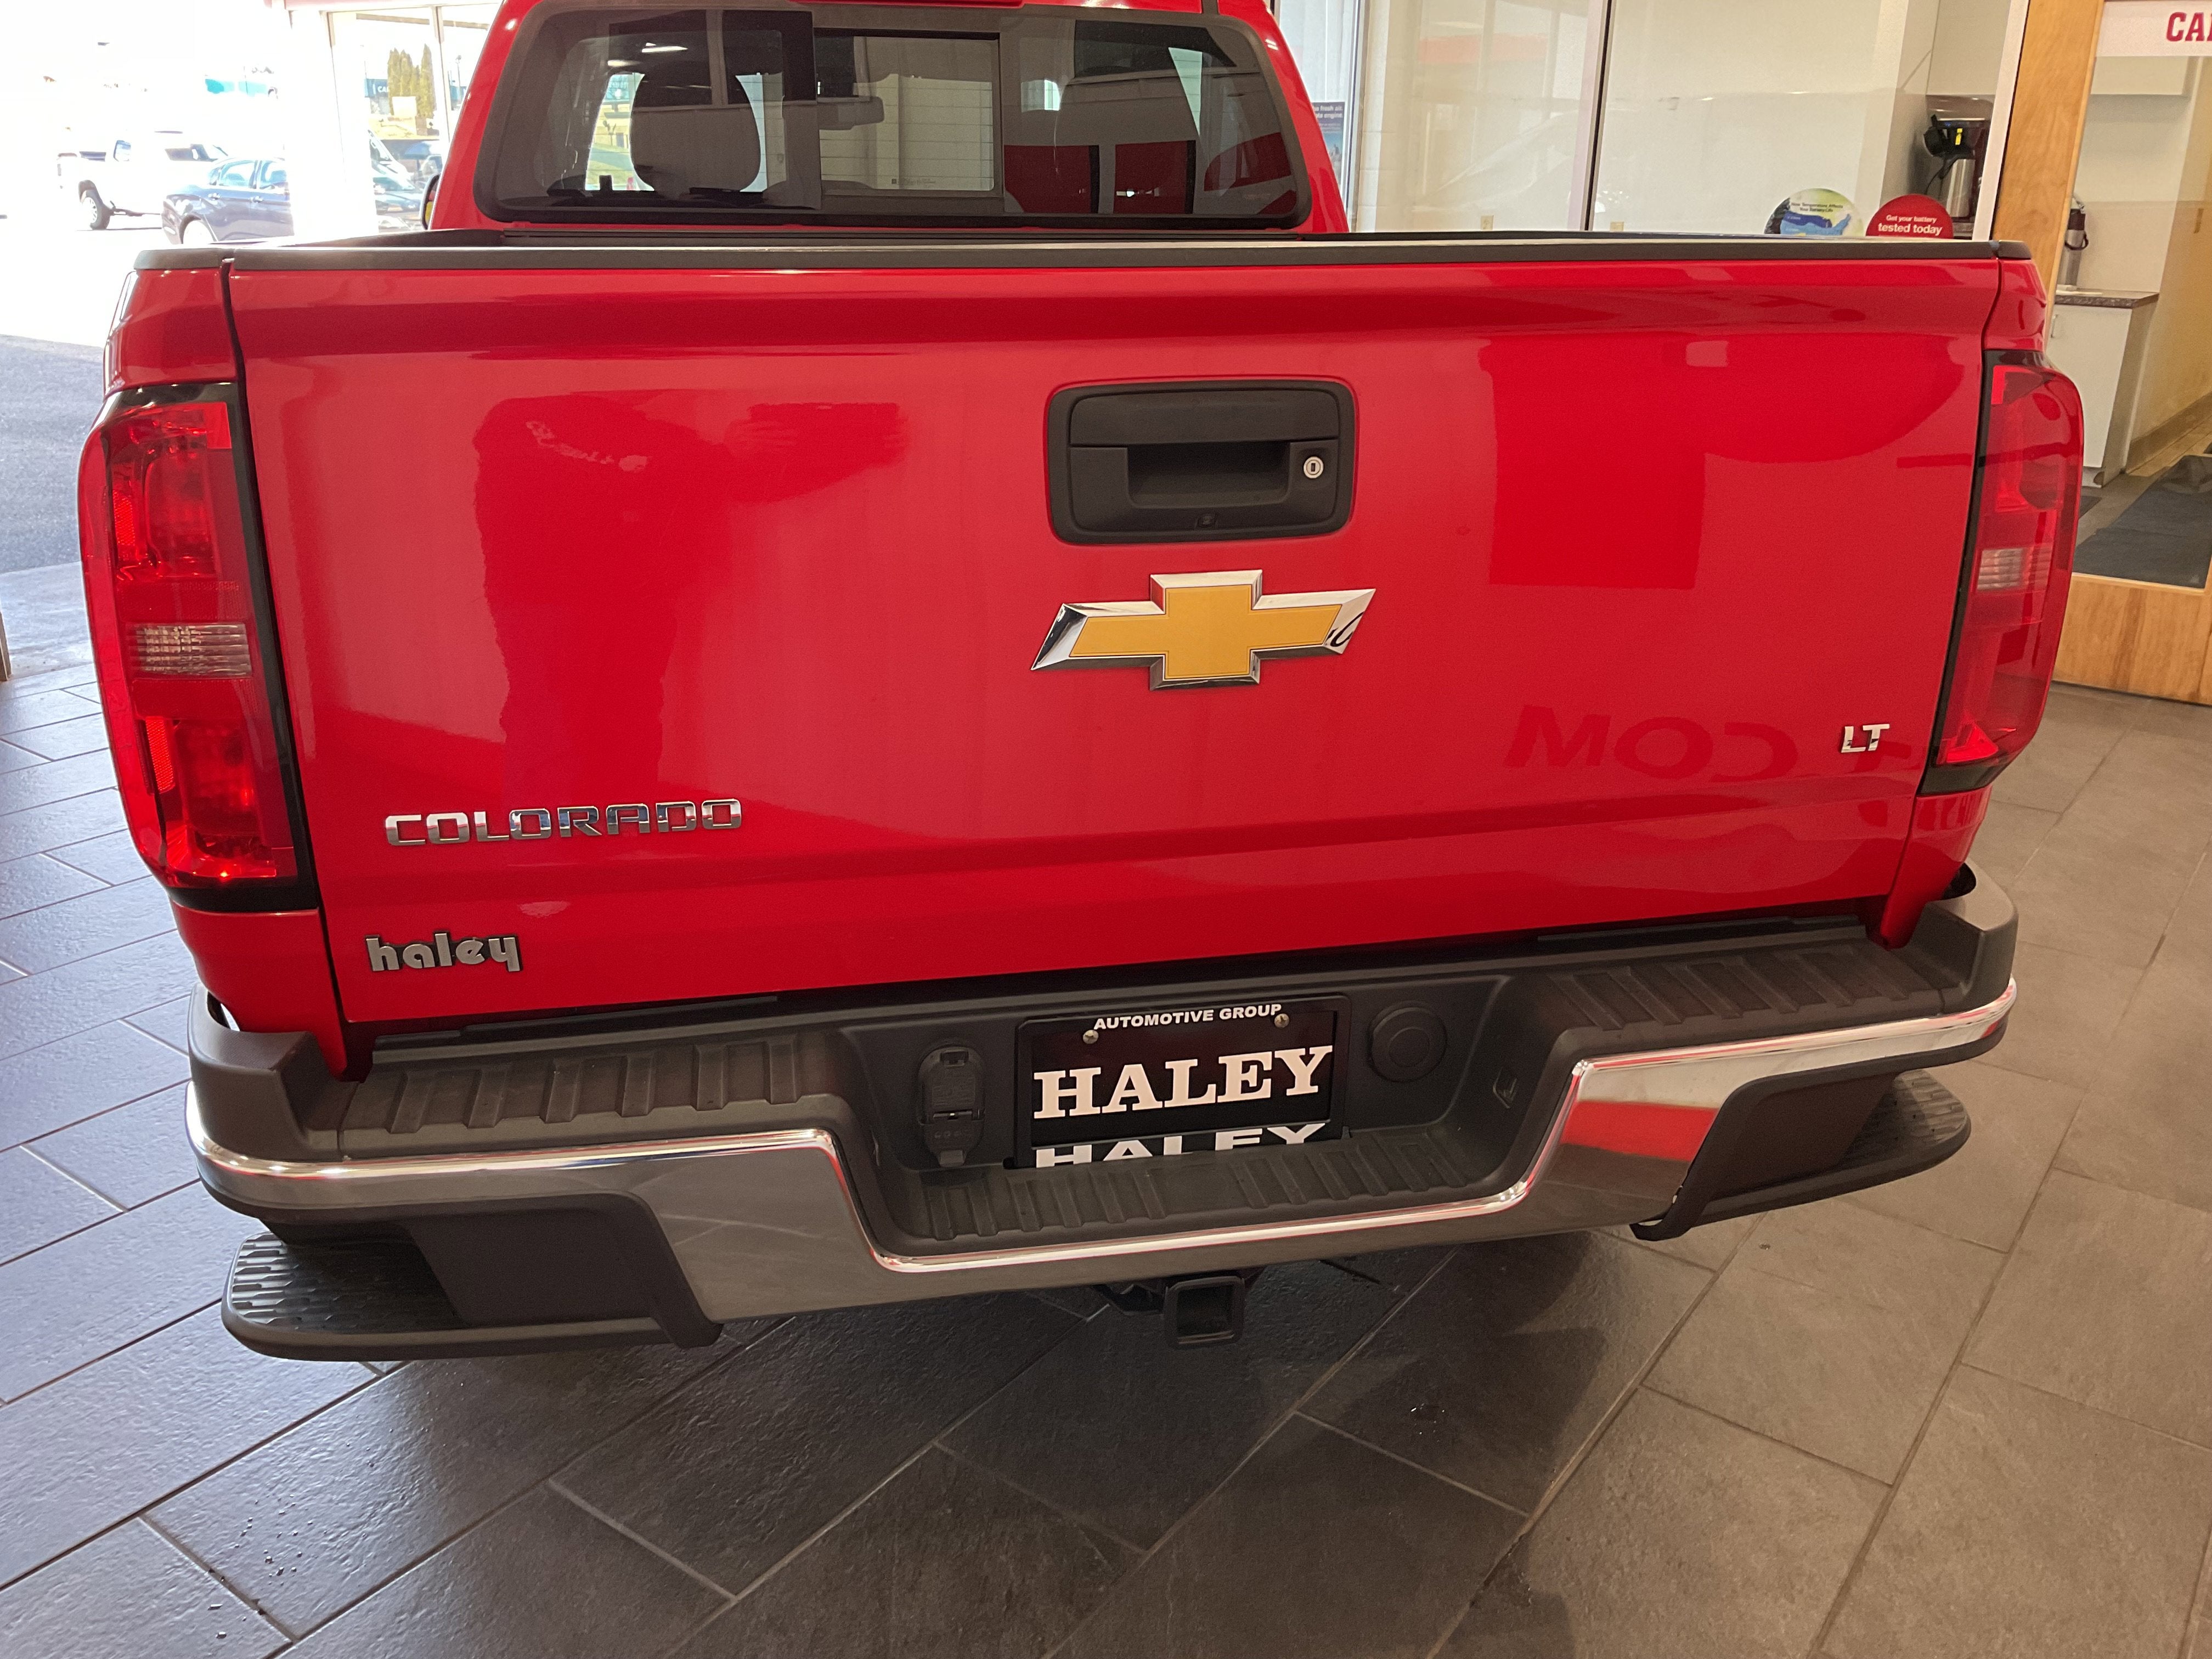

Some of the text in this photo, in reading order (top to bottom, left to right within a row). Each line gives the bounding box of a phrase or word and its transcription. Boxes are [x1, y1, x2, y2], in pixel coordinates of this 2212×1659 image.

[2166, 12, 2212, 41] CA
[1878, 223, 1943, 236] tested today
[1914, 216, 1937, 224] battery
[1841, 724, 1890, 753] LT
[385, 798, 742, 846] COLORADO
[366, 932, 522, 972] haley
[1093, 1003, 1282, 1030] AUTOMOTIVE GROUP
[1034, 1045, 1333, 1119] HALEY
